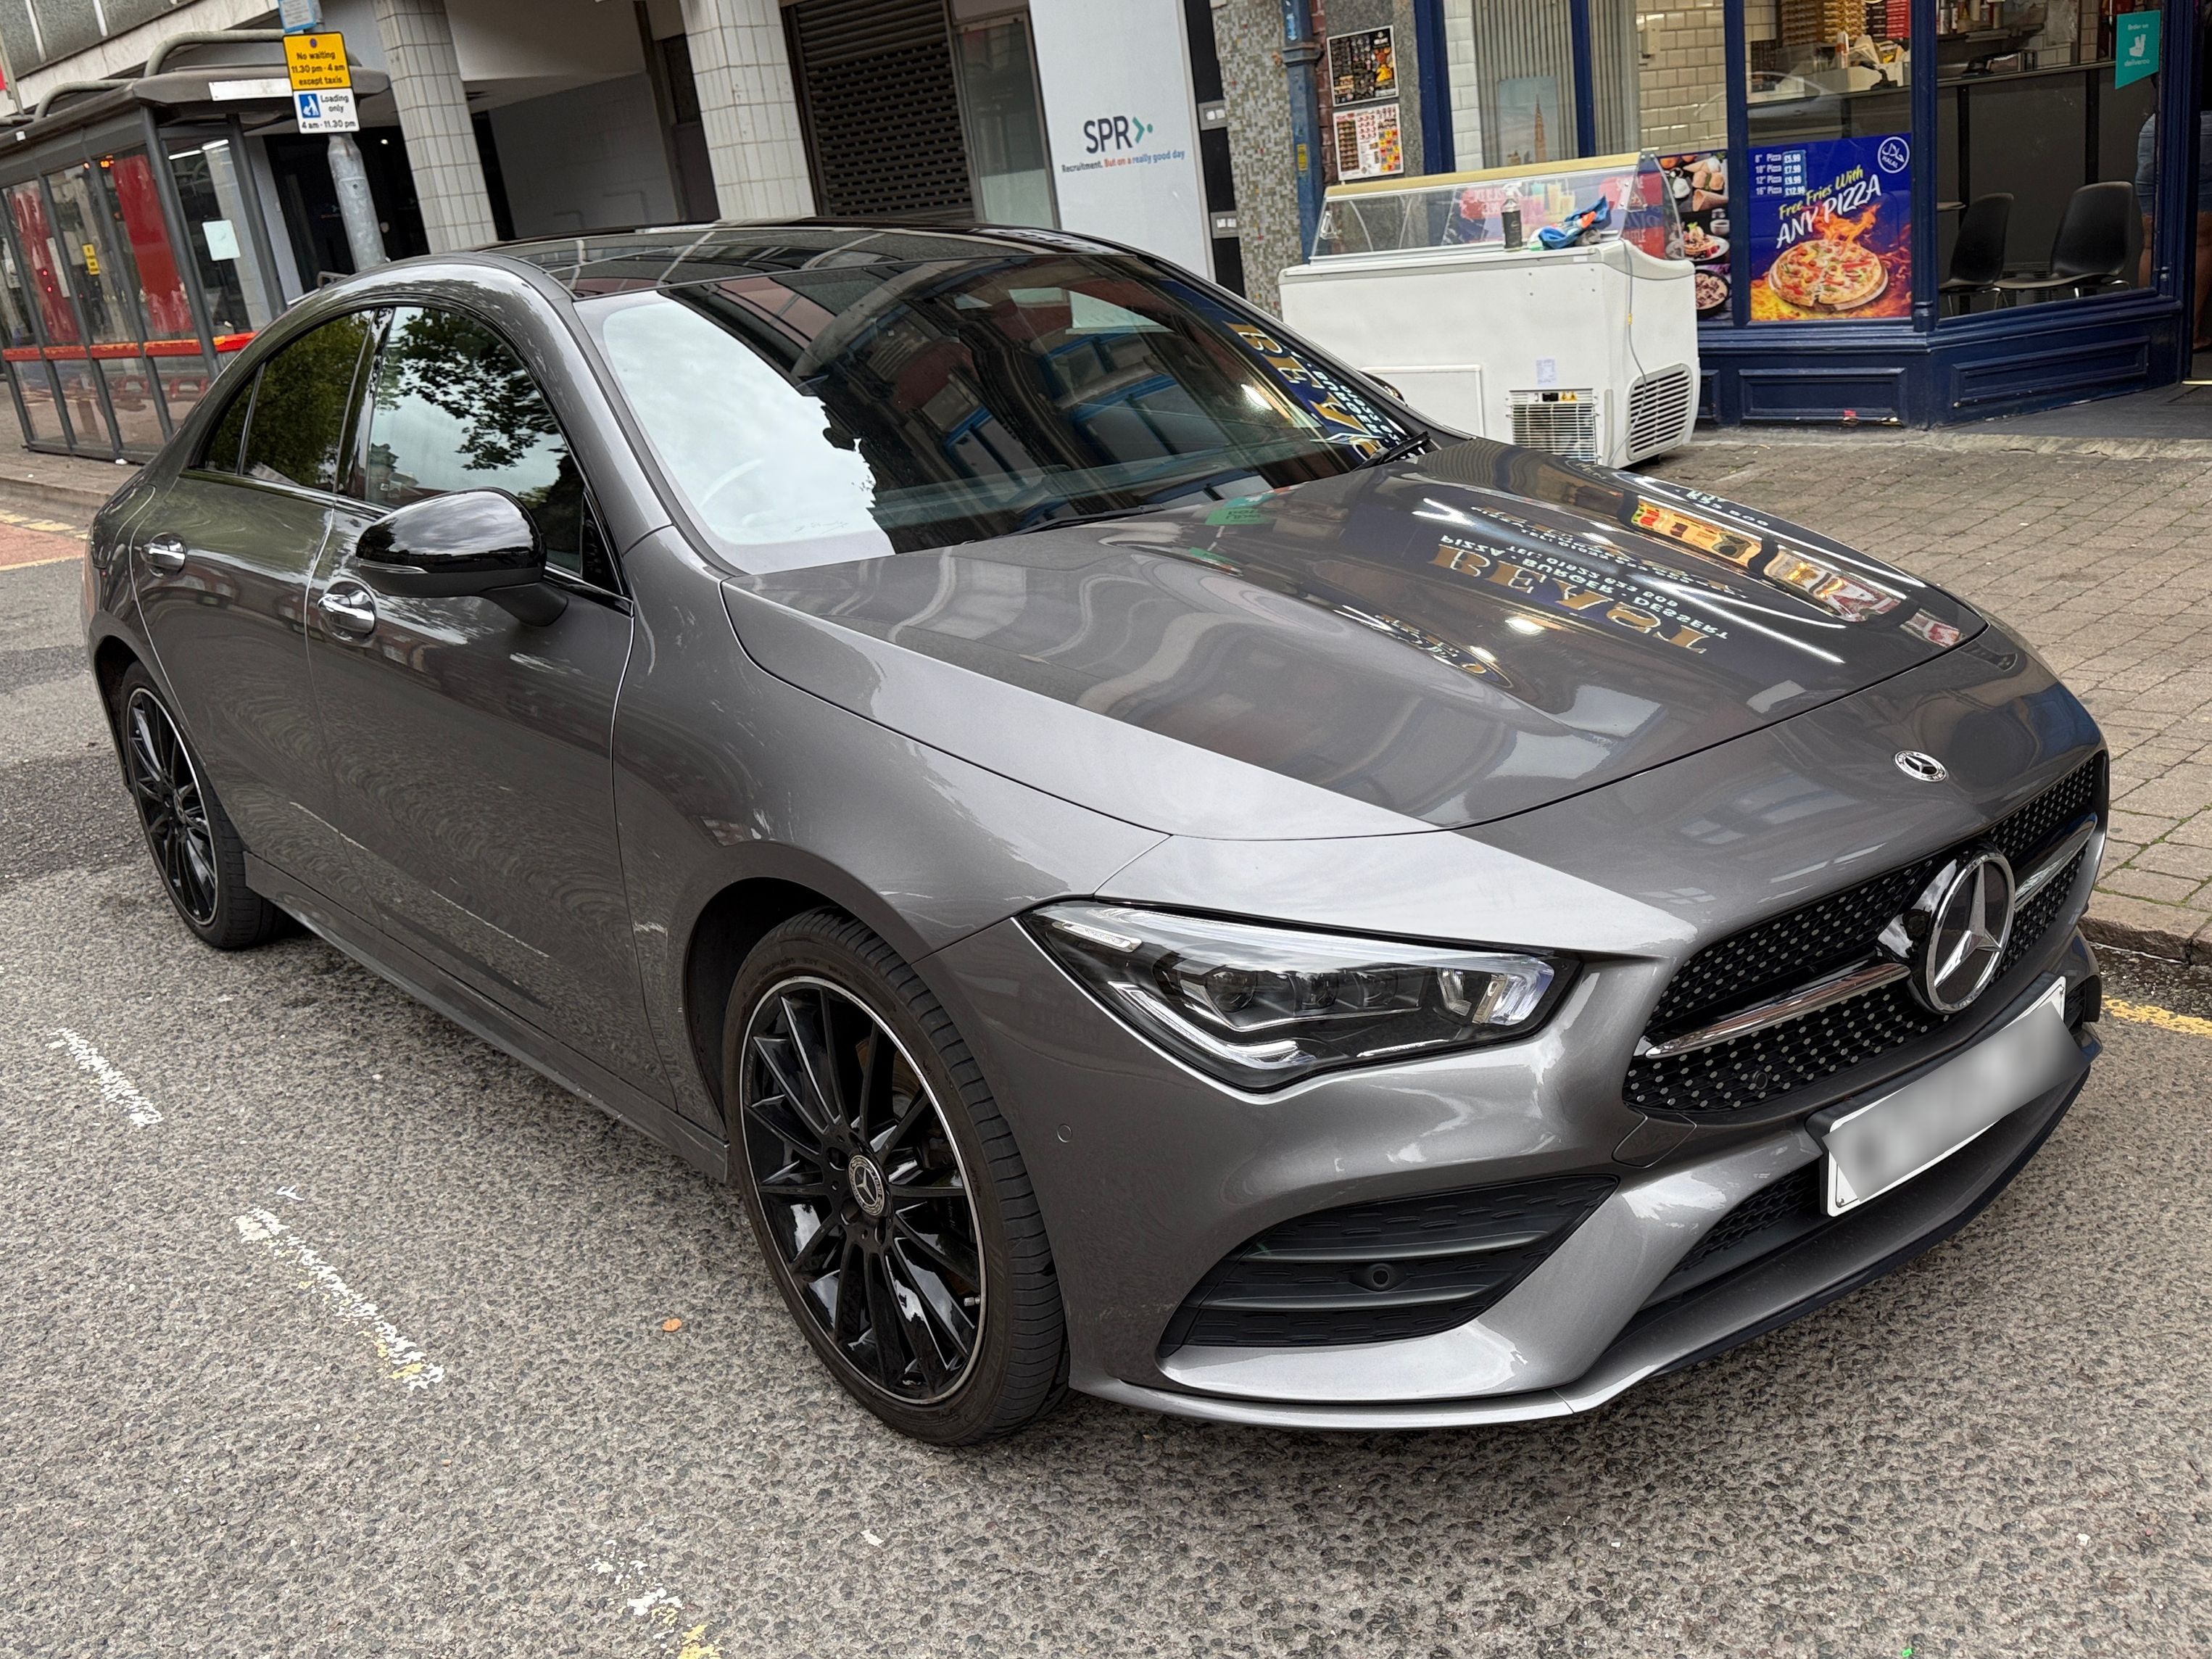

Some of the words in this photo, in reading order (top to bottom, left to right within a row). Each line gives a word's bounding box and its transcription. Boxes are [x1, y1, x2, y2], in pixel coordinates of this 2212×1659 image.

[309, 51, 336, 60] waiting
[328, 63, 334, 72] 4
[299, 78, 323, 86] except
[324, 75, 343, 85] taxis
[320, 94, 349, 104] Loading
[328, 104, 344, 113] only
[323, 120, 344, 128] 11.30
[344, 120, 357, 128] pm
[1083, 115, 1133, 154] SPR
[1061, 160, 1103, 173] Recruitment.
[1103, 157, 1117, 168] But
[1117, 158, 1127, 167] on
[1132, 153, 1152, 165] really
[1153, 149, 1172, 163] good
[1172, 149, 1186, 160] day
[1766, 153, 1782, 162] Pizza
[1767, 164, 1782, 173] Pizza
[1767, 175, 1783, 184] Pizza
[1767, 186, 1783, 195] Pizza
[1779, 200, 1803, 220] Free
[1806, 184, 1833, 206] Fries
[1835, 164, 1863, 190] With
[1776, 206, 1818, 249] ANY
[1822, 174, 1882, 223] PIZZA
